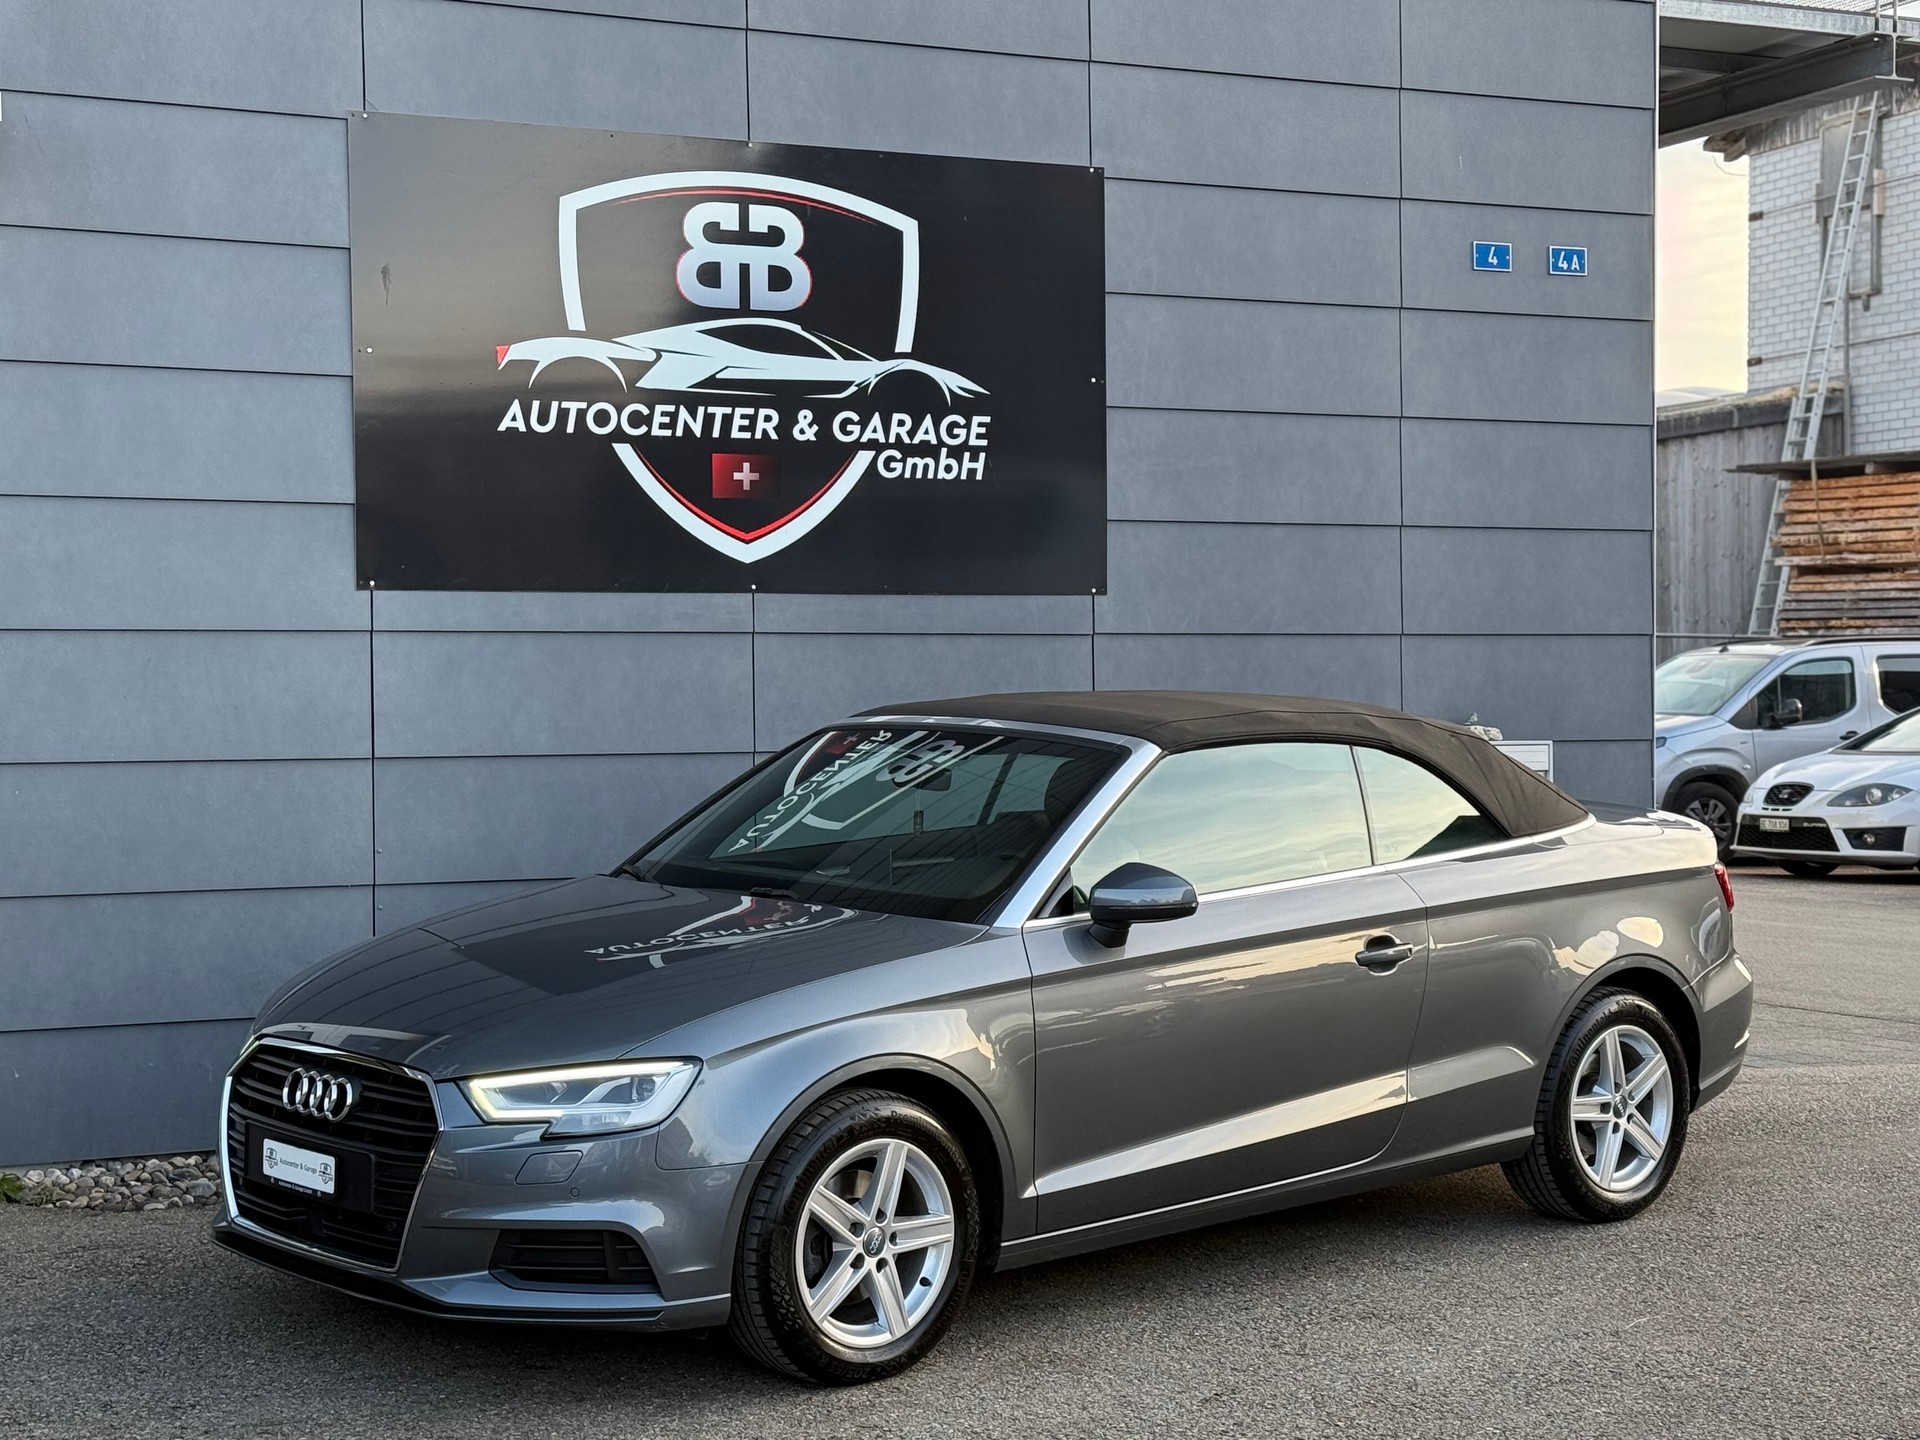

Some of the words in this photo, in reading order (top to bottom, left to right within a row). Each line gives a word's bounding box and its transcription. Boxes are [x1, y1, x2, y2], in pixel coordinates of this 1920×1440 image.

[1488, 246, 1498, 266] 4
[1558, 251, 1580, 271] 4A
[497, 399, 779, 440] AUTOCENTER
[792, 410, 818, 441] &
[832, 411, 991, 447] GARAGE
[877, 448, 985, 481] GmbH
